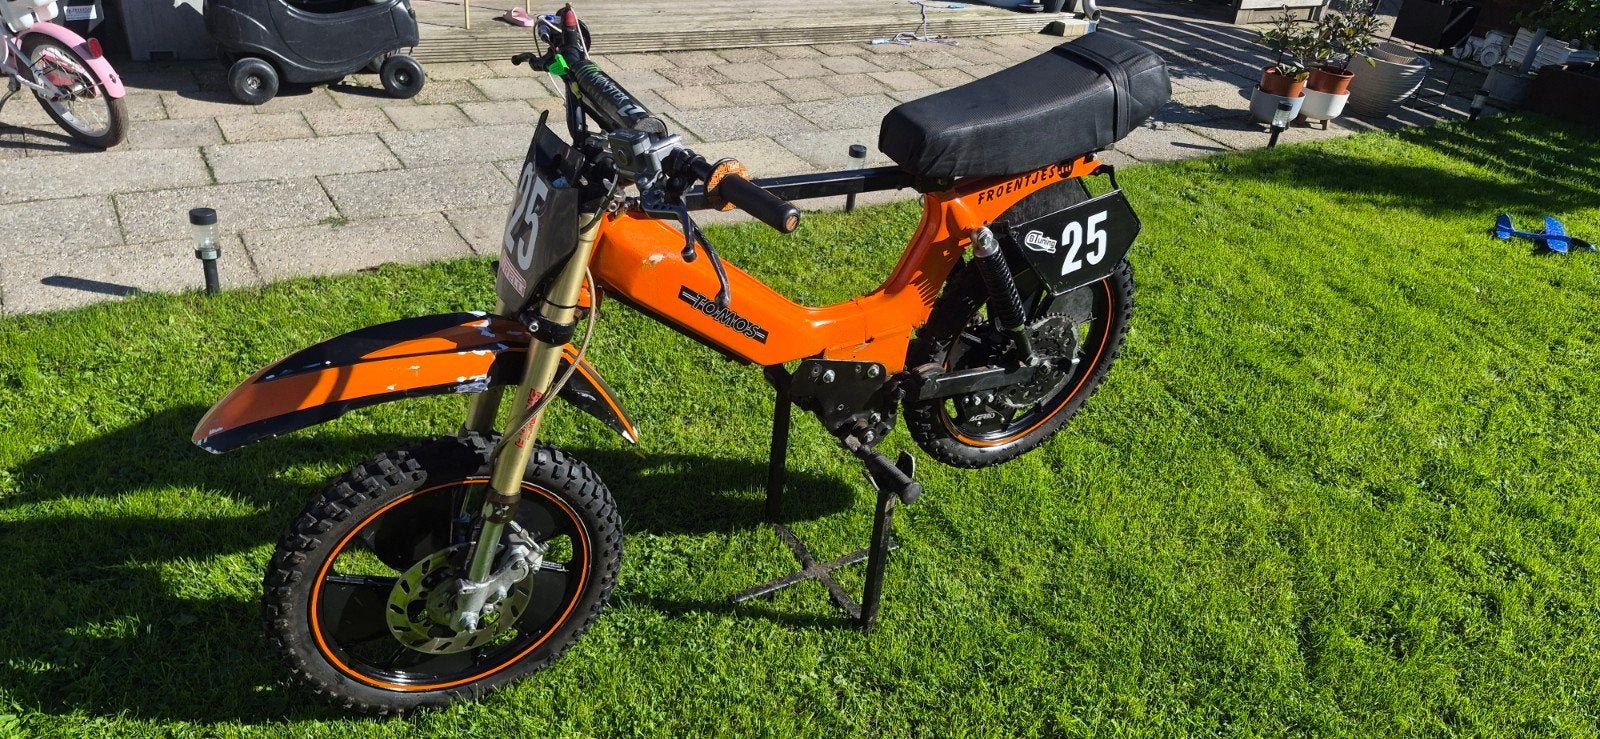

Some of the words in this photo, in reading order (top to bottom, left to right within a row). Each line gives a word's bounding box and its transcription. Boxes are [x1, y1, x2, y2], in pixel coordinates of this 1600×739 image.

[977, 164, 1056, 205] FROENTJES
[504, 161, 549, 271] 25
[1061, 210, 1107, 276] 25
[690, 292, 761, 339] TOMOS
